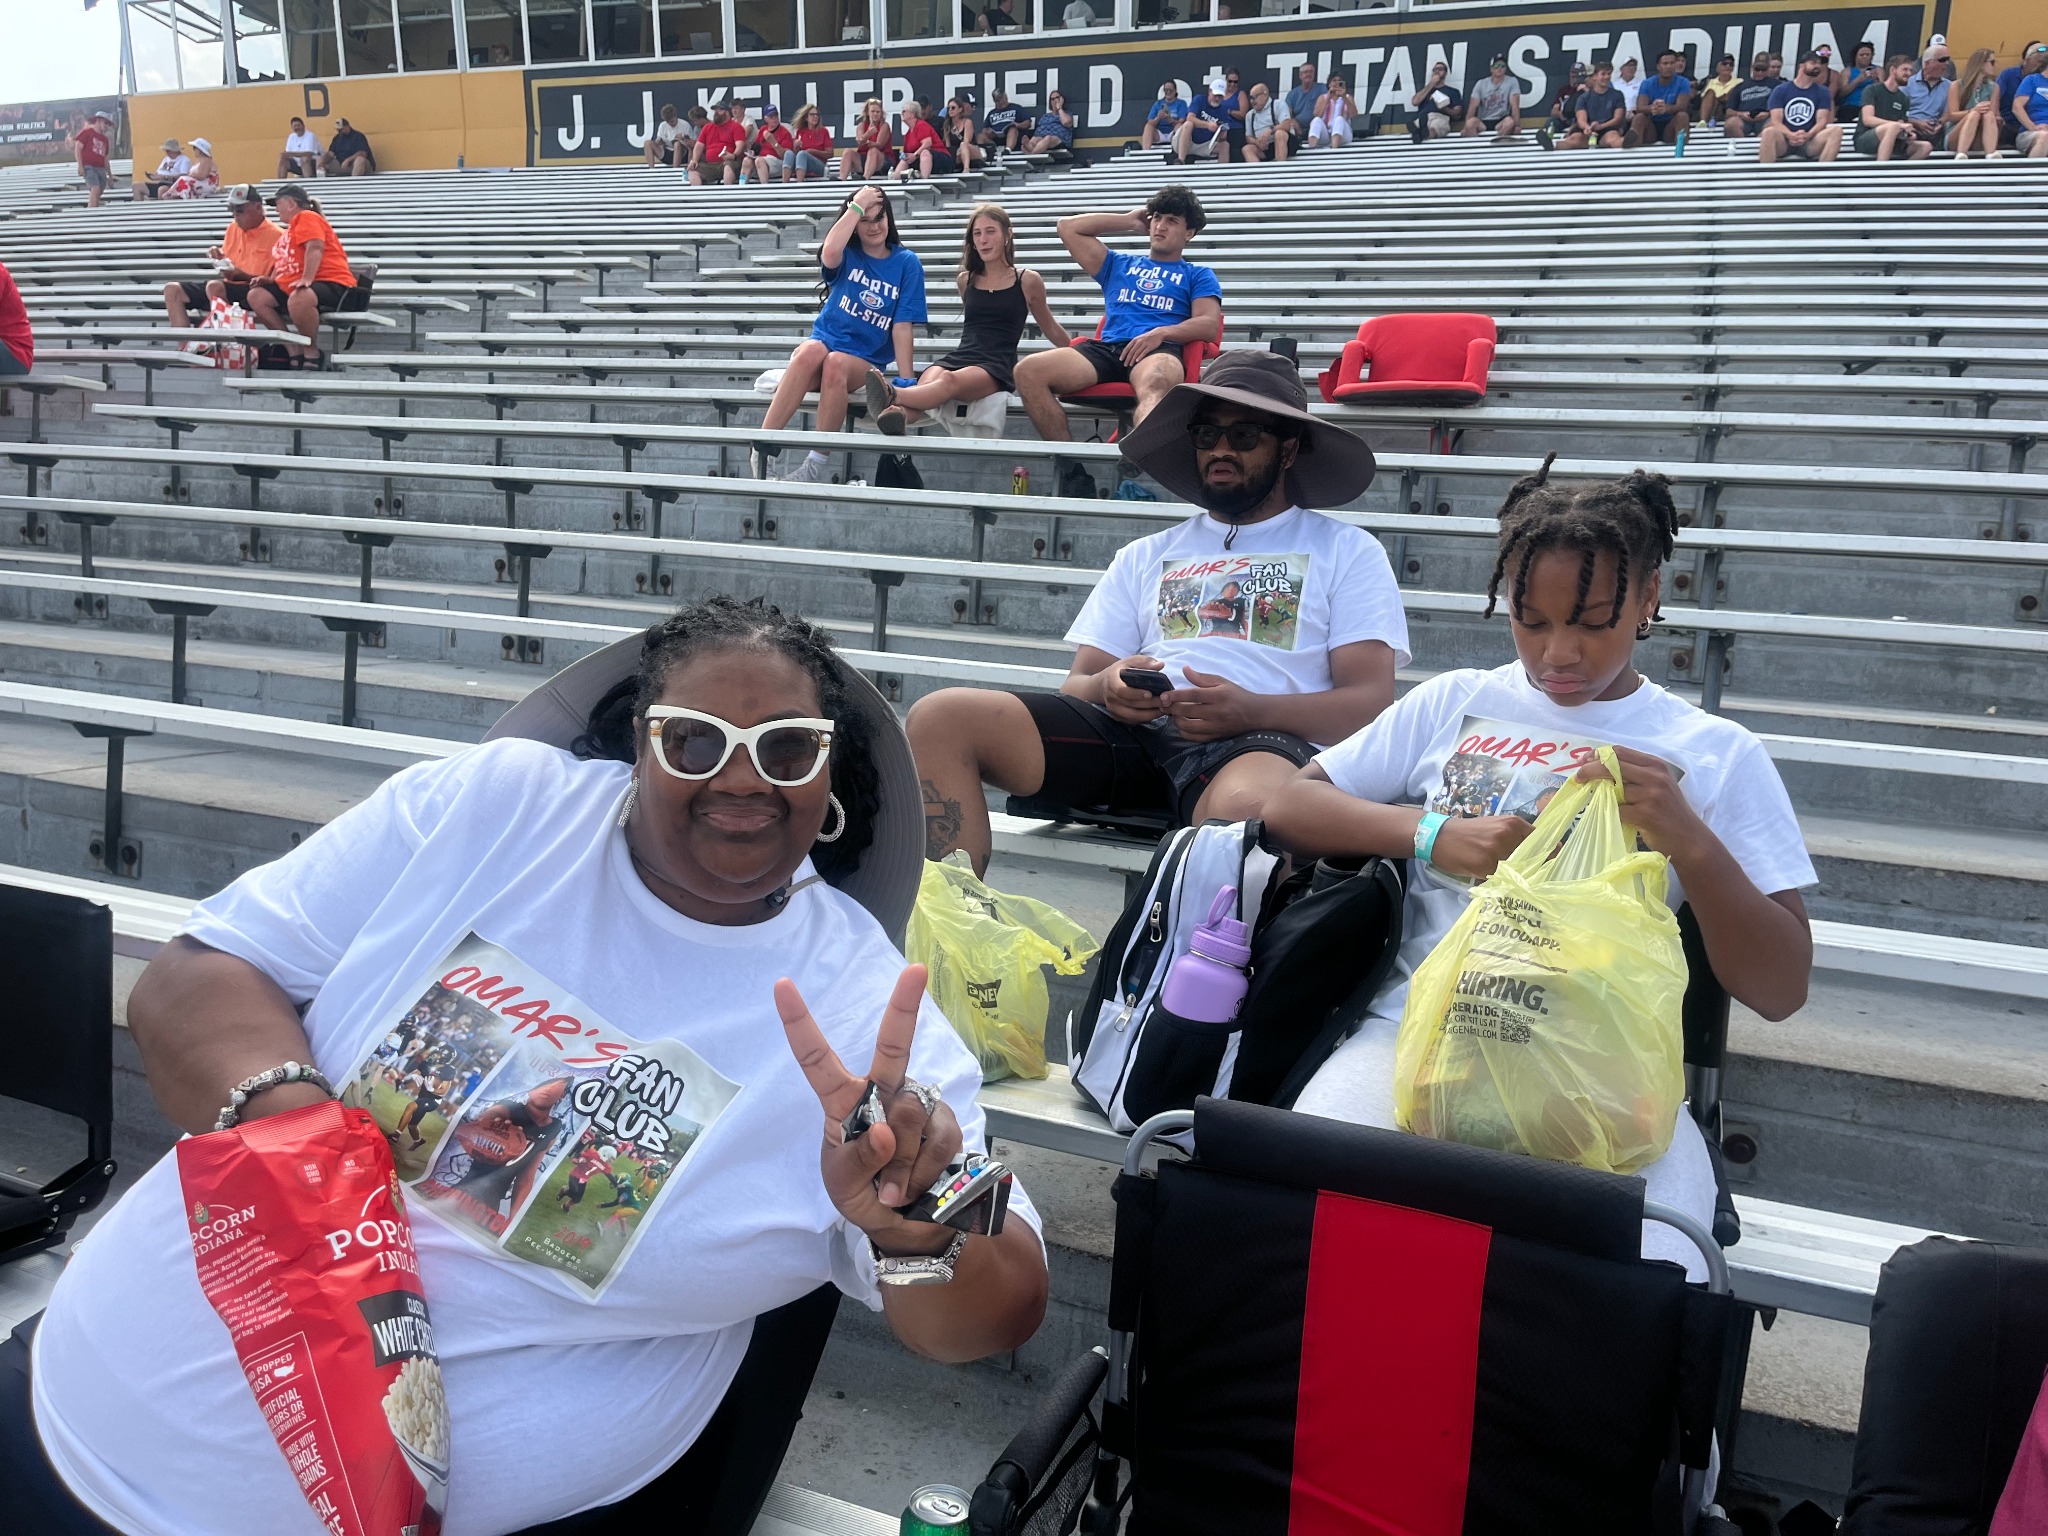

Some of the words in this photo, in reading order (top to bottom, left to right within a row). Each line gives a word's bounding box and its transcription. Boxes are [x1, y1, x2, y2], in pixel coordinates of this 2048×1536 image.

[558, 94, 601, 151] J.
[943, 64, 1124, 132] FIELD
[1266, 42, 1468, 115] TITAN
[1507, 20, 1890, 109] STADIUM
[303, 83, 330, 117] D
[1117, 288, 1174, 310] ALL-STAR
[1163, 557, 1251, 581] OMAR'S
[1250, 562, 1287, 577] FAN
[1242, 577, 1293, 595] CLUB
[1458, 735, 1593, 772] OMAR'S
[1488, 923, 1510, 937] ON
[1455, 970, 1549, 1015] HIRING.
[440, 966, 628, 1063] OMAR'S
[1484, 1005, 1500, 1018] DG.
[606, 1054, 684, 1118] FAN
[573, 1079, 672, 1153] CLUB
[213, 1249, 236, 1267] popcorn
[221, 1259, 241, 1272] Across
[240, 1246, 264, 1260] America
[264, 1250, 275, 1258] are
[525, 1236, 562, 1264] PEE-WEE
[544, 1237, 582, 1264] BADGERS
[244, 1290, 257, 1300] take
[258, 1279, 272, 1293] great
[247, 1289, 273, 1307] American
[256, 1291, 288, 1313] ingredients
[373, 1315, 419, 1357] WHITE
[256, 1352, 293, 1376] POPPED
[253, 1373, 272, 1393] USA
[290, 1400, 304, 1414] OR
[299, 1430, 316, 1449] WITH
[291, 1442, 321, 1473] WHOLE
